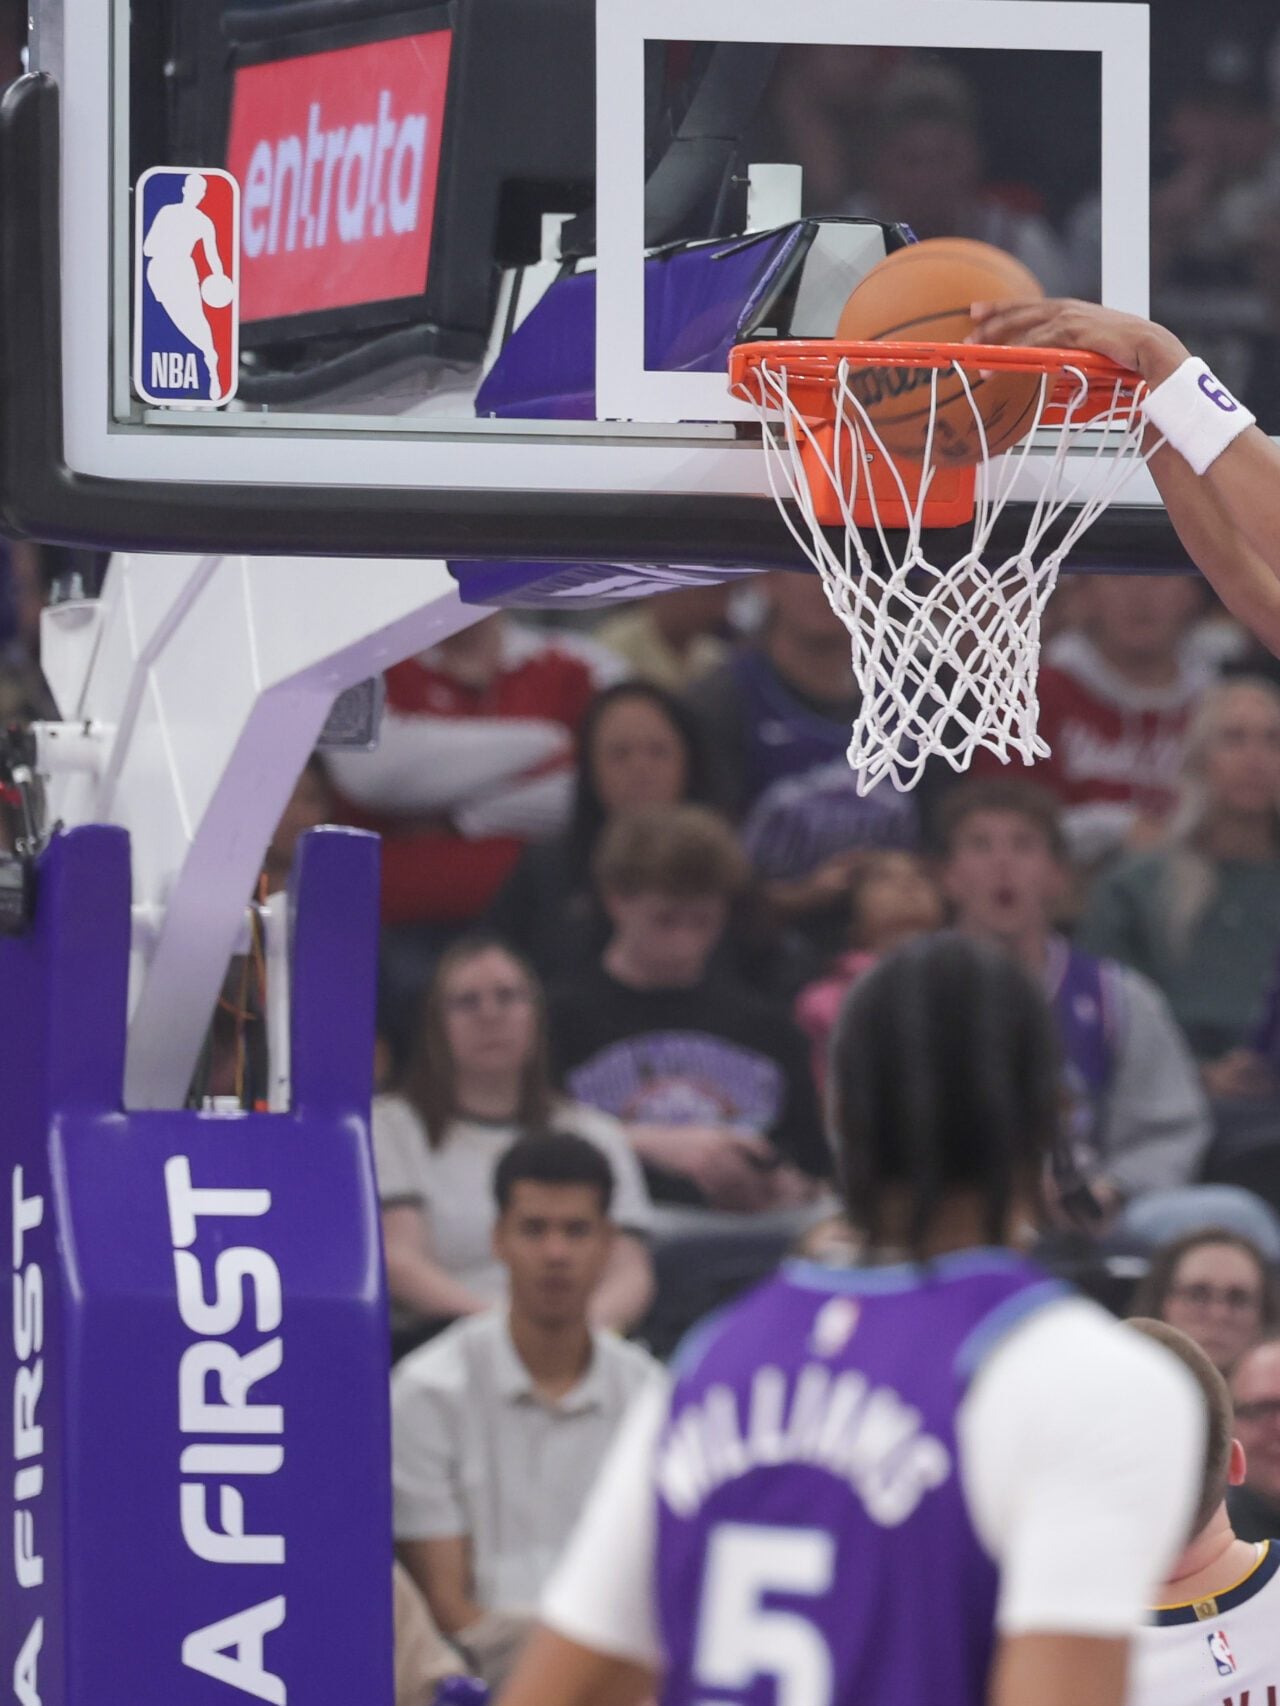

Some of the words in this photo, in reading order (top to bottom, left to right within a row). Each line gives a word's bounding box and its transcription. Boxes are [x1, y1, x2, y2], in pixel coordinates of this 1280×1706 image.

[241, 90, 427, 259] entrata
[151, 352, 199, 389] NBA
[12, 1163, 44, 1588] FIRST
[163, 1154, 286, 1565] FIRST
[660, 1361, 951, 1528] WILLIAMS
[182, 1594, 287, 1706] A
[692, 1521, 835, 1706] 5
